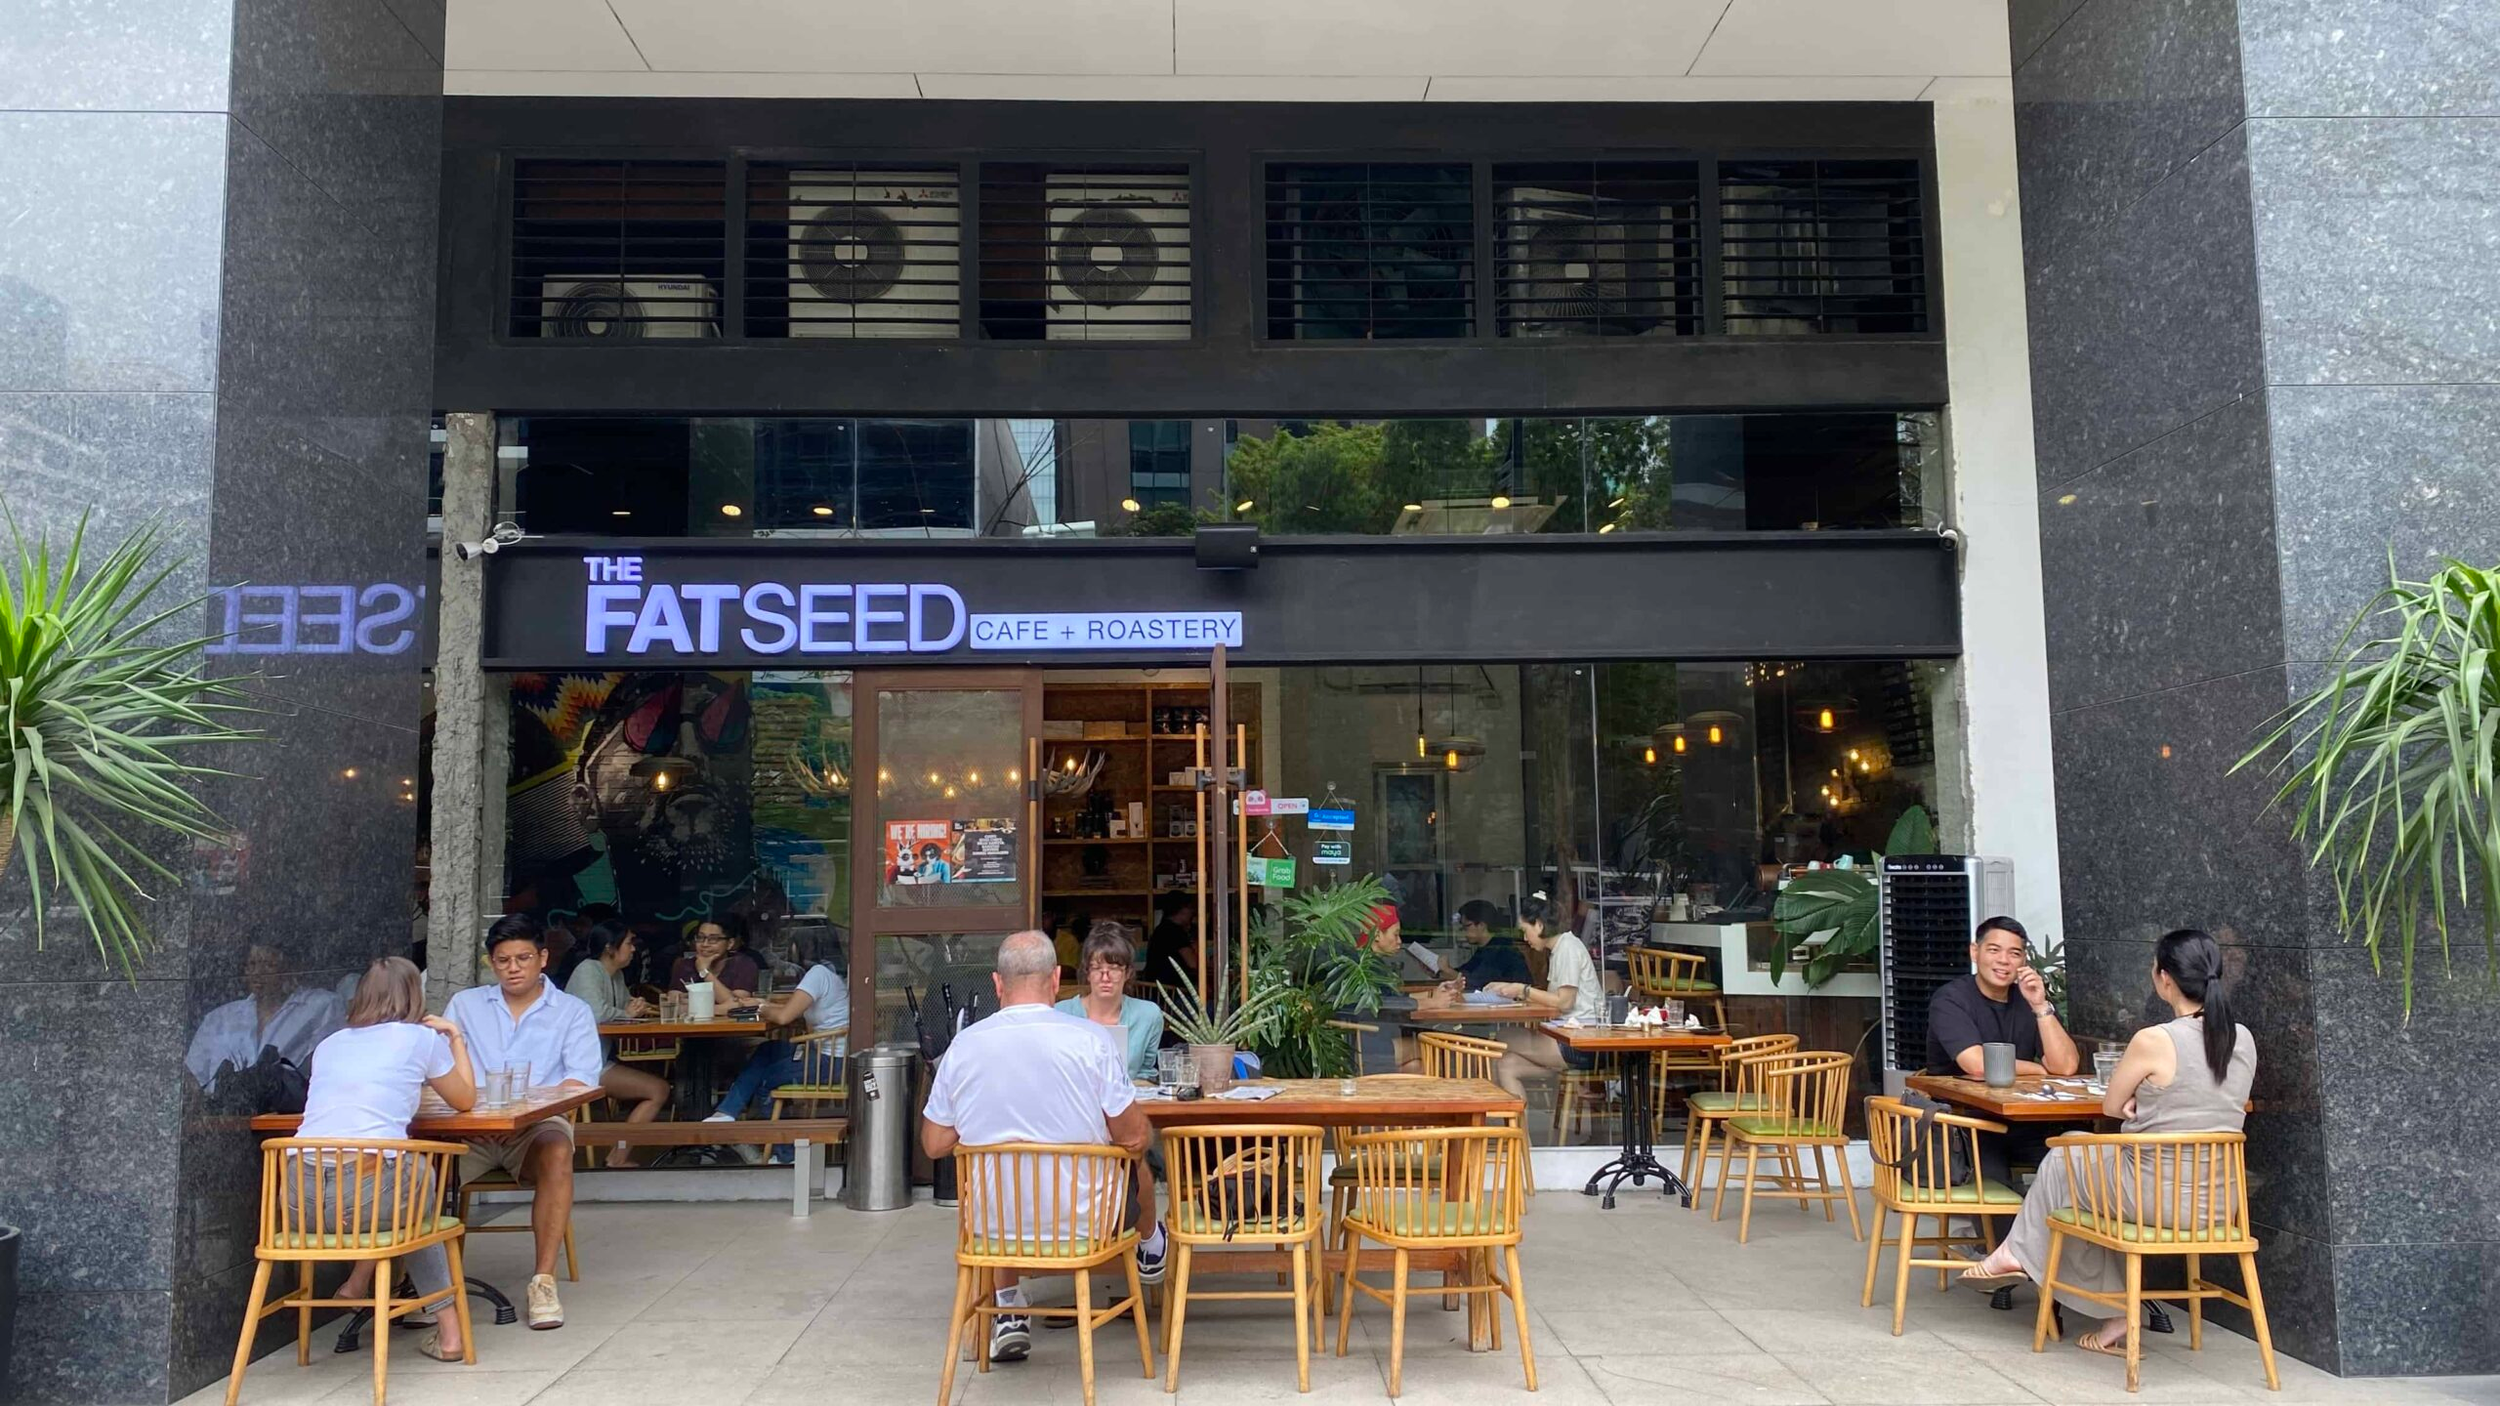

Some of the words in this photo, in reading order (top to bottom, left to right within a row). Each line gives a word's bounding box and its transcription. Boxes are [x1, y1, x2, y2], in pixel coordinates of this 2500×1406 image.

[583, 556, 643, 583] THE
[976, 620, 1048, 641] CAFE
[1087, 618, 1236, 640] ROASTERY
[1277, 802, 1298, 810] OPEN
[1272, 866, 1291, 874] Grab
[1272, 873, 1291, 881] Food
